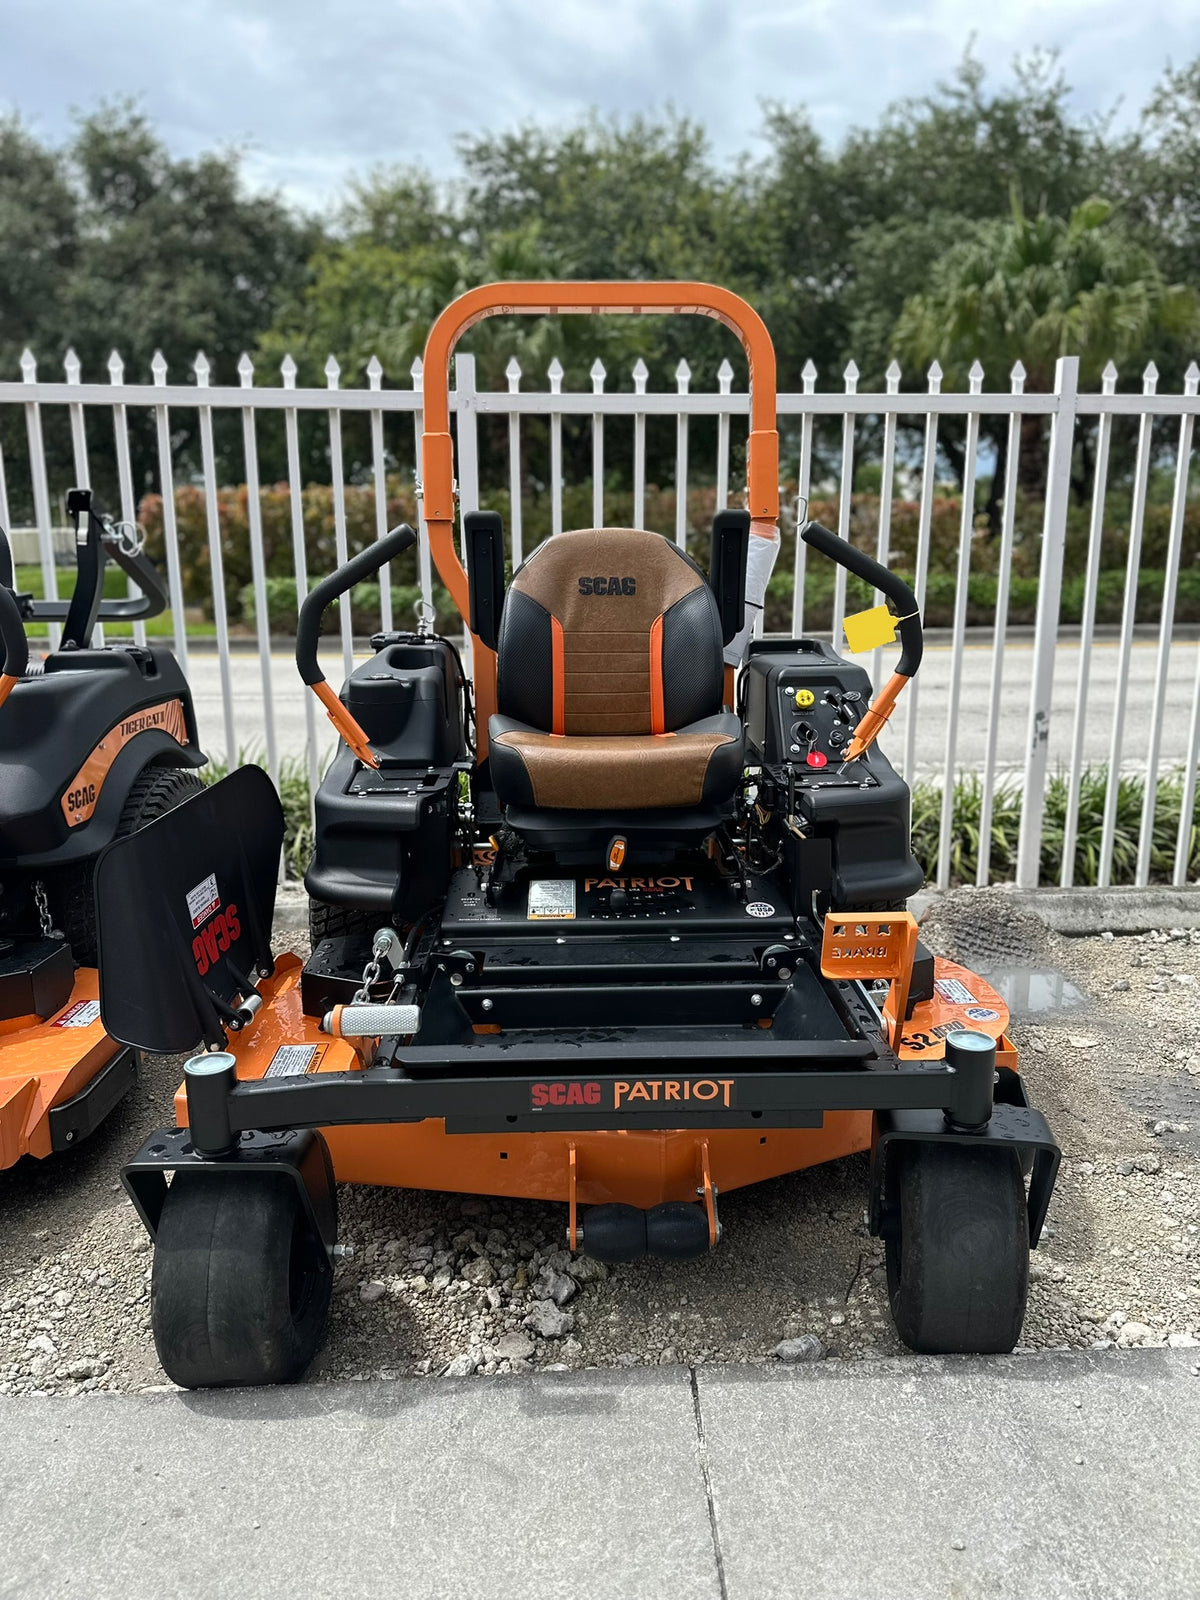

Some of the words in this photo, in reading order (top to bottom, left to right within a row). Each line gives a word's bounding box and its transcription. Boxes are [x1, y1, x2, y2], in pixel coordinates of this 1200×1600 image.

[578, 577, 636, 595] SCAG
[120, 719, 145, 737] TIGER
[146, 711, 161, 728] CAT
[67, 783, 96, 812] SCAG
[584, 877, 694, 893] PATRIOT
[192, 904, 241, 976] SCAG
[531, 1082, 601, 1106] SCAG
[613, 1080, 735, 1110] PATRIOT
